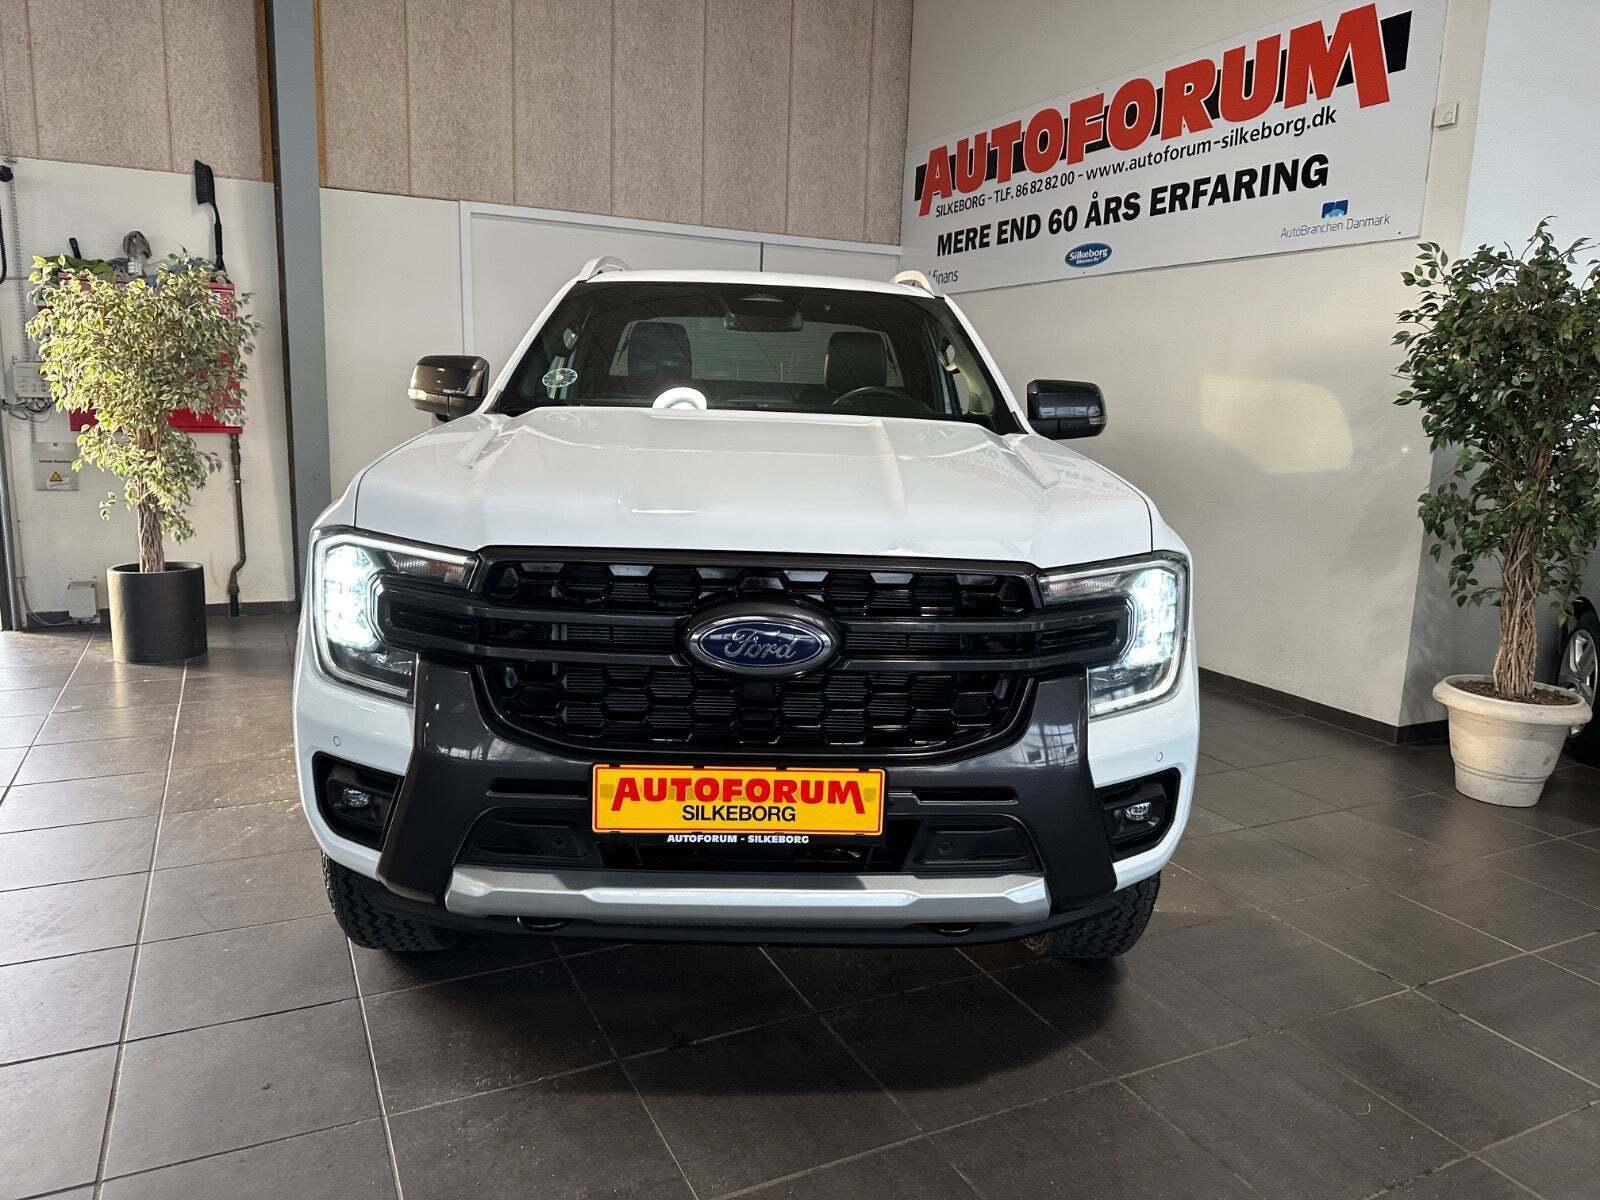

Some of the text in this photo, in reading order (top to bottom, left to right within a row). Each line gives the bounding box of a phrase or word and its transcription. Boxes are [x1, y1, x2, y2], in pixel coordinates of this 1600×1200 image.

[919, 3, 1390, 217] AUTOFORUM
[935, 194, 986, 218] SILKEBORG
[994, 187, 1014, 203] TLF.
[1085, 105, 1337, 181] www.autoforum-silkeborg.dk
[936, 153, 1329, 257] MERE END 60 ÅRS ERFARING
[1280, 213, 1391, 239] AutoBranchen Danmark
[1069, 248, 1108, 261] Silkeborg
[724, 628, 798, 660] Ford
[611, 777, 866, 815] AUTOFORUM
[682, 805, 796, 822] SILKEBORG
[667, 834, 737, 844] AUTOFORUM
[748, 835, 809, 844] SILKEBORG
